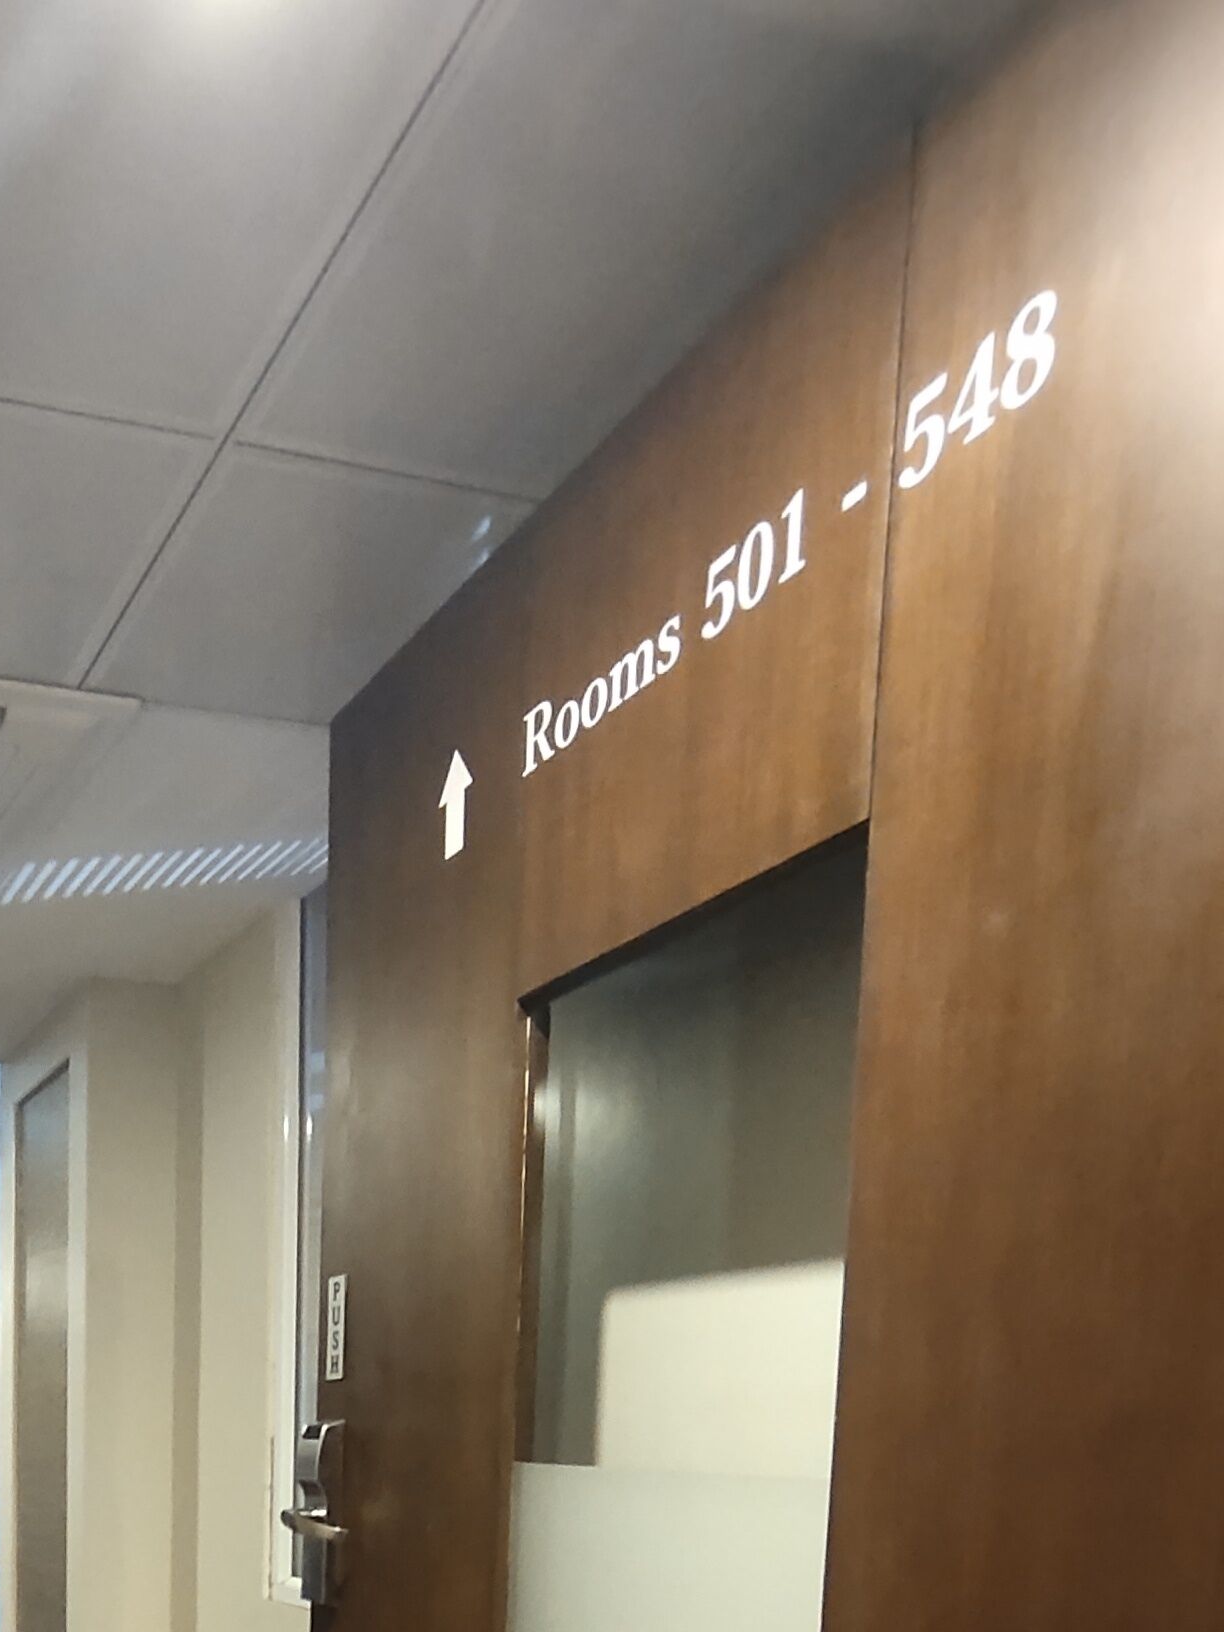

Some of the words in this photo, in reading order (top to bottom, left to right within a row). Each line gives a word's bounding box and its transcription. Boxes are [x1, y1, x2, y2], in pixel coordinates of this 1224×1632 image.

[522, 614, 681, 778] Rooms
[701, 488, 806, 639] 501
[841, 480, 868, 512] -
[898, 288, 1059, 489] 548
[330, 1281, 342, 1374] PUSH
